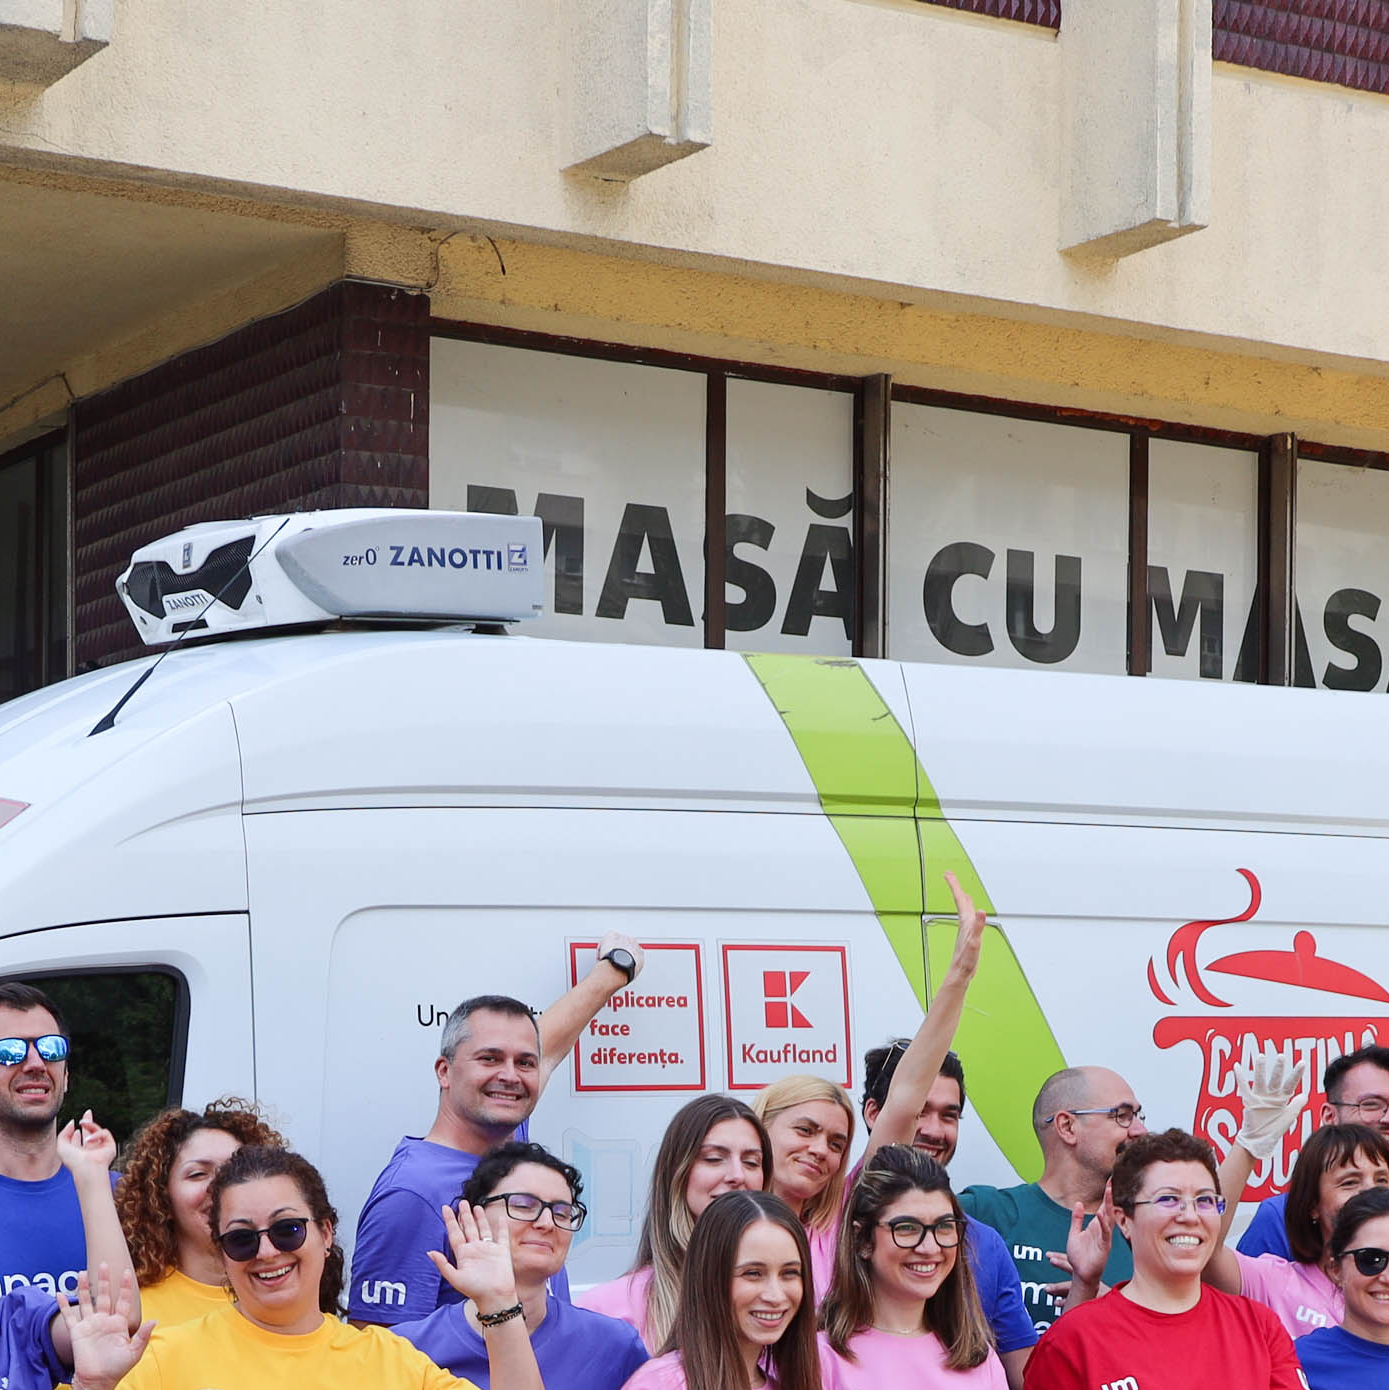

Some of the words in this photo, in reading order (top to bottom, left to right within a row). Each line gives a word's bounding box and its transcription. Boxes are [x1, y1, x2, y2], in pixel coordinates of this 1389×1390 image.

[389, 545, 503, 571] ZANOTTI
[164, 593, 210, 610] ZANOTTI
[922, 541, 1082, 665] CU
[607, 990, 688, 1012] plicarea
[590, 1019, 630, 1036] face
[590, 1047, 684, 1069] diferența.
[742, 1043, 837, 1065] Kaufland
[1013, 1244, 1043, 1261] um
[361, 1279, 407, 1306] um
[1296, 1304, 1327, 1326] um
